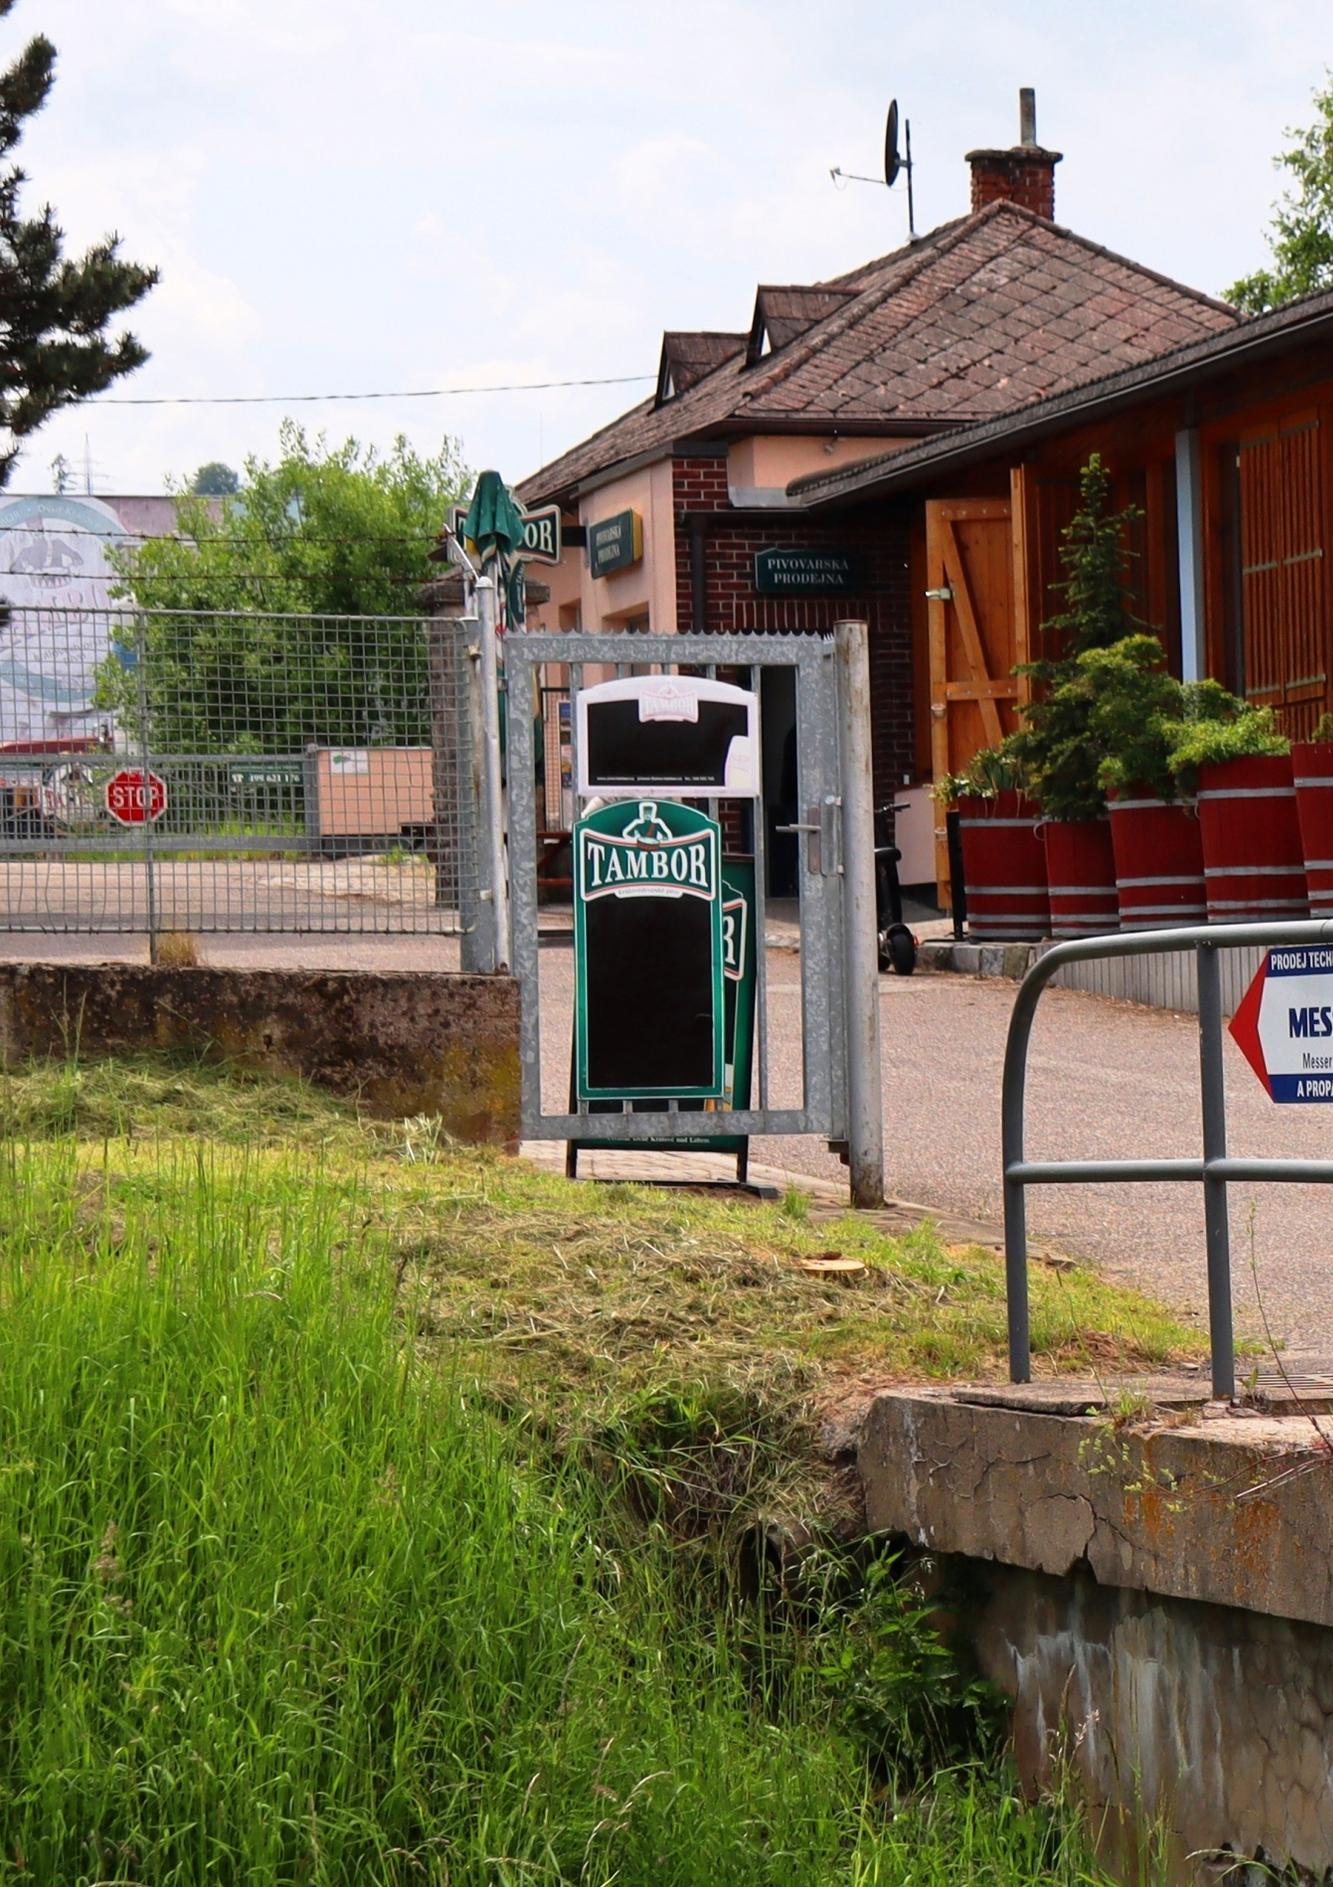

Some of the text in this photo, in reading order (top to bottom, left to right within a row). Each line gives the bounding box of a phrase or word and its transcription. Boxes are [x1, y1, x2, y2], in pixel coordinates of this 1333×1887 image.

[773, 573, 844, 584] PRODEJNA
[112, 786, 159, 808] STOP
[587, 841, 709, 887] TAMBOR
[1270, 952, 1307, 970] PRODEJ
[1302, 1053, 1332, 1069] Messer
[1297, 1081, 1304, 1097] A
